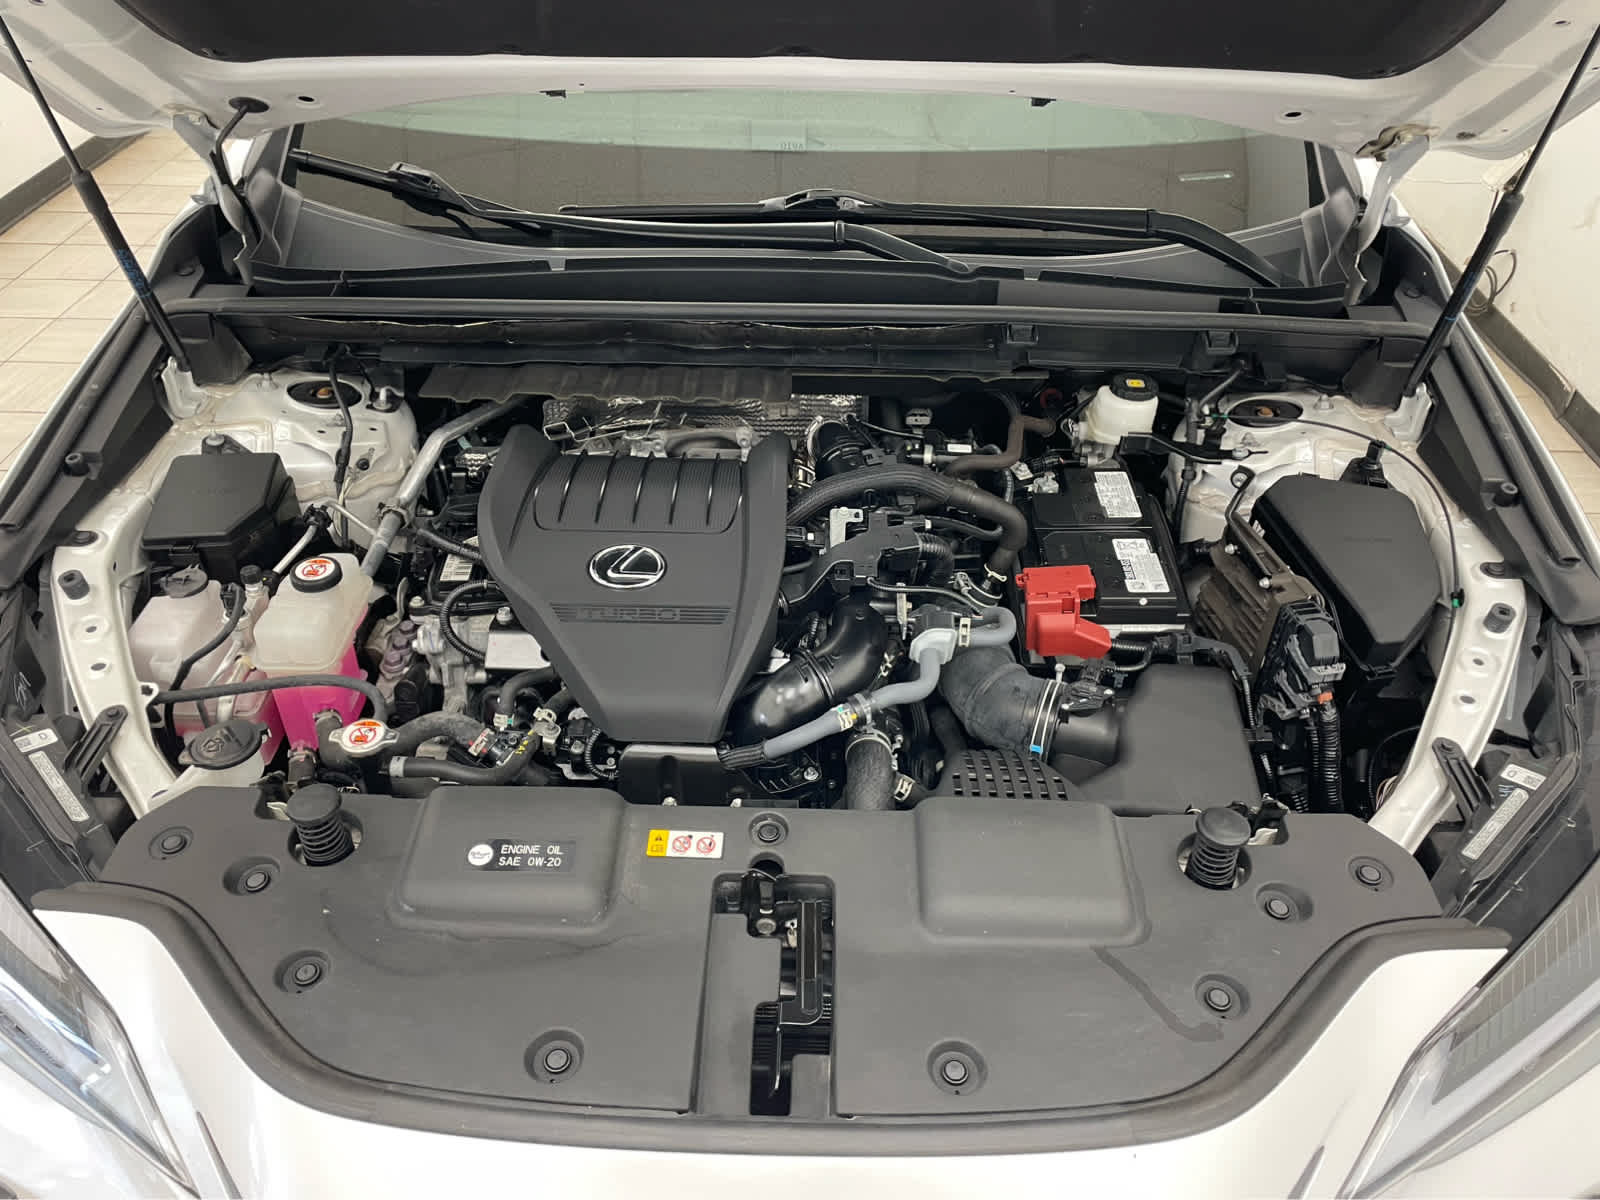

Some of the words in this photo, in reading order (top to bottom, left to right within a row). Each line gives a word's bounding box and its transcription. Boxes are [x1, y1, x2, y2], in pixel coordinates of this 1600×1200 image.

[576, 606, 680, 621] TURBO
[500, 844, 541, 854] ENGINE
[547, 845, 564, 855] OIL
[498, 856, 521, 866] SAE
[527, 857, 562, 867] 0W-20
